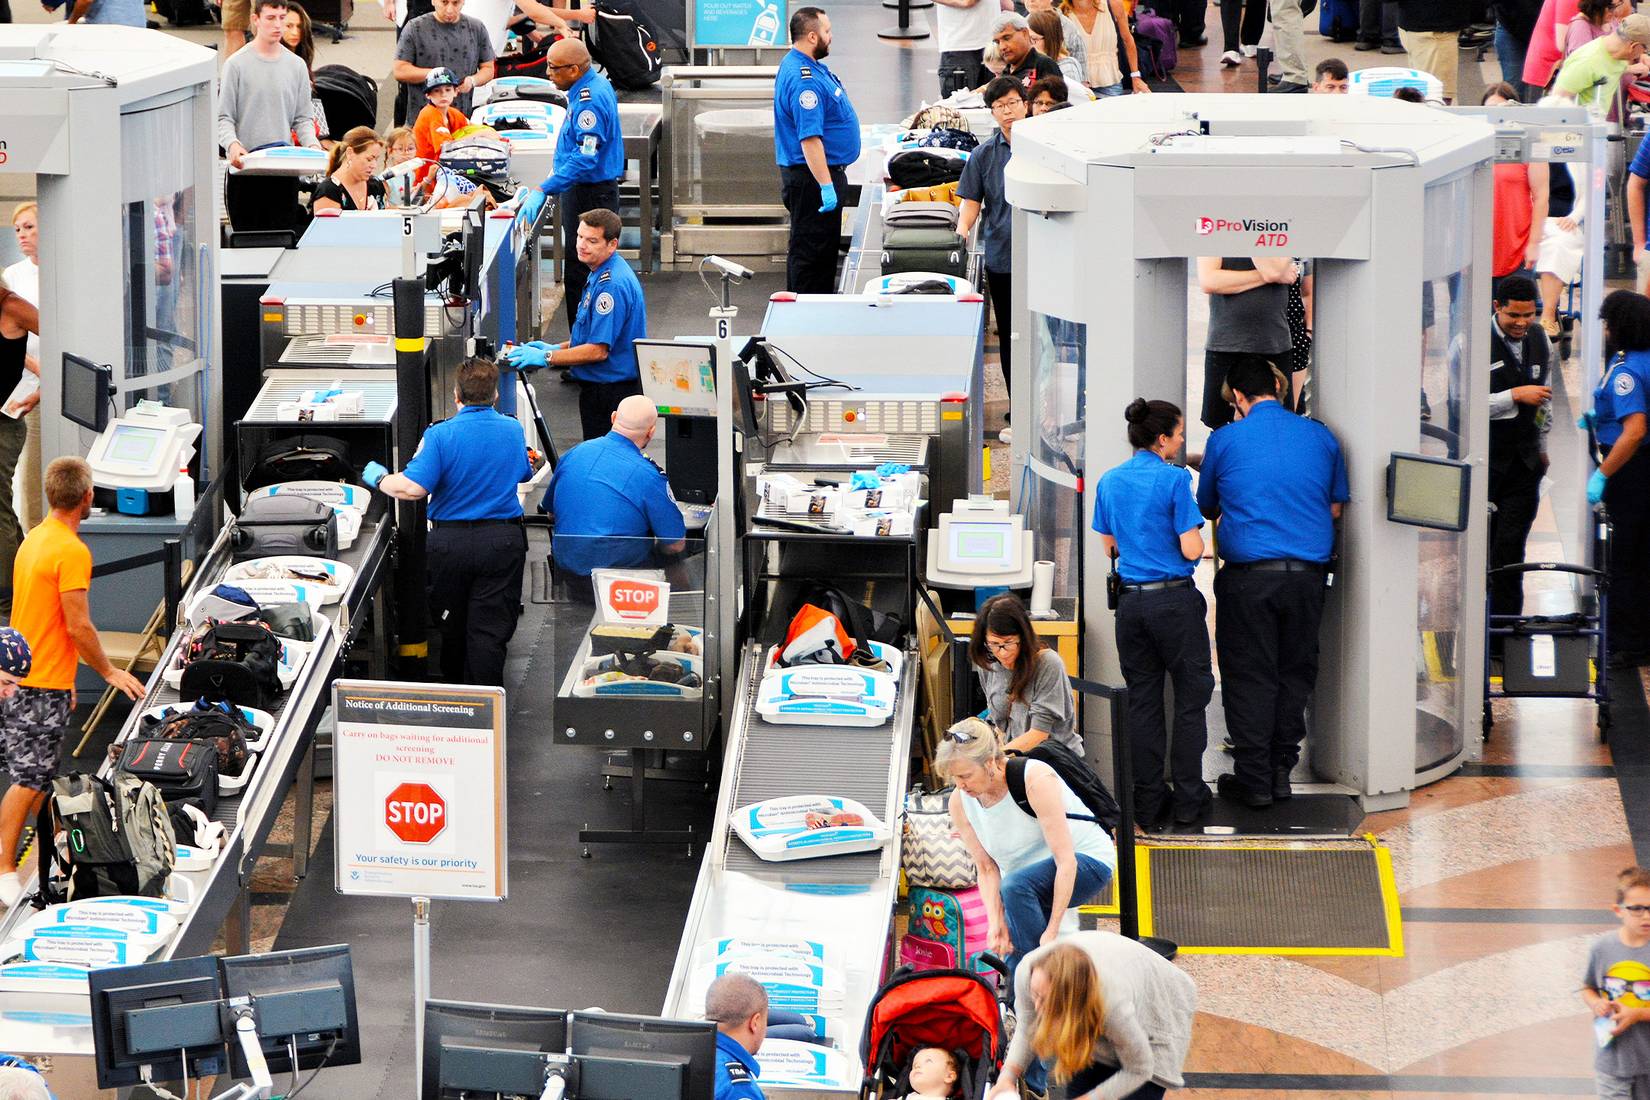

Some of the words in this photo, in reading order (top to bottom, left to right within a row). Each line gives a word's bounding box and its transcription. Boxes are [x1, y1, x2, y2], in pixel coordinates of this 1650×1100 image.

[404, 217, 412, 235] 5
[1255, 234, 1288, 246] ATD
[718, 320, 727, 339] 6
[614, 589, 655, 603] STOP
[345, 700, 373, 710] Notice
[375, 700, 384, 710] of
[386, 702, 431, 712] Additional
[432, 704, 474, 716] Screening
[342, 730, 365, 739] Carry
[380, 731, 398, 740] bags
[400, 733, 430, 743] waiting
[432, 734, 444, 742] for
[446, 734, 488, 744] additional
[396, 745, 434, 754] screening
[375, 754, 390, 762] DO
[392, 754, 412, 763] NOT
[415, 755, 456, 766] REMOVE
[388, 800, 444, 824] STOP
[355, 853, 377, 864] Your
[380, 854, 409, 866] safety
[411, 856, 420, 865] is
[421, 858, 438, 866] our
[440, 858, 478, 869] priority
